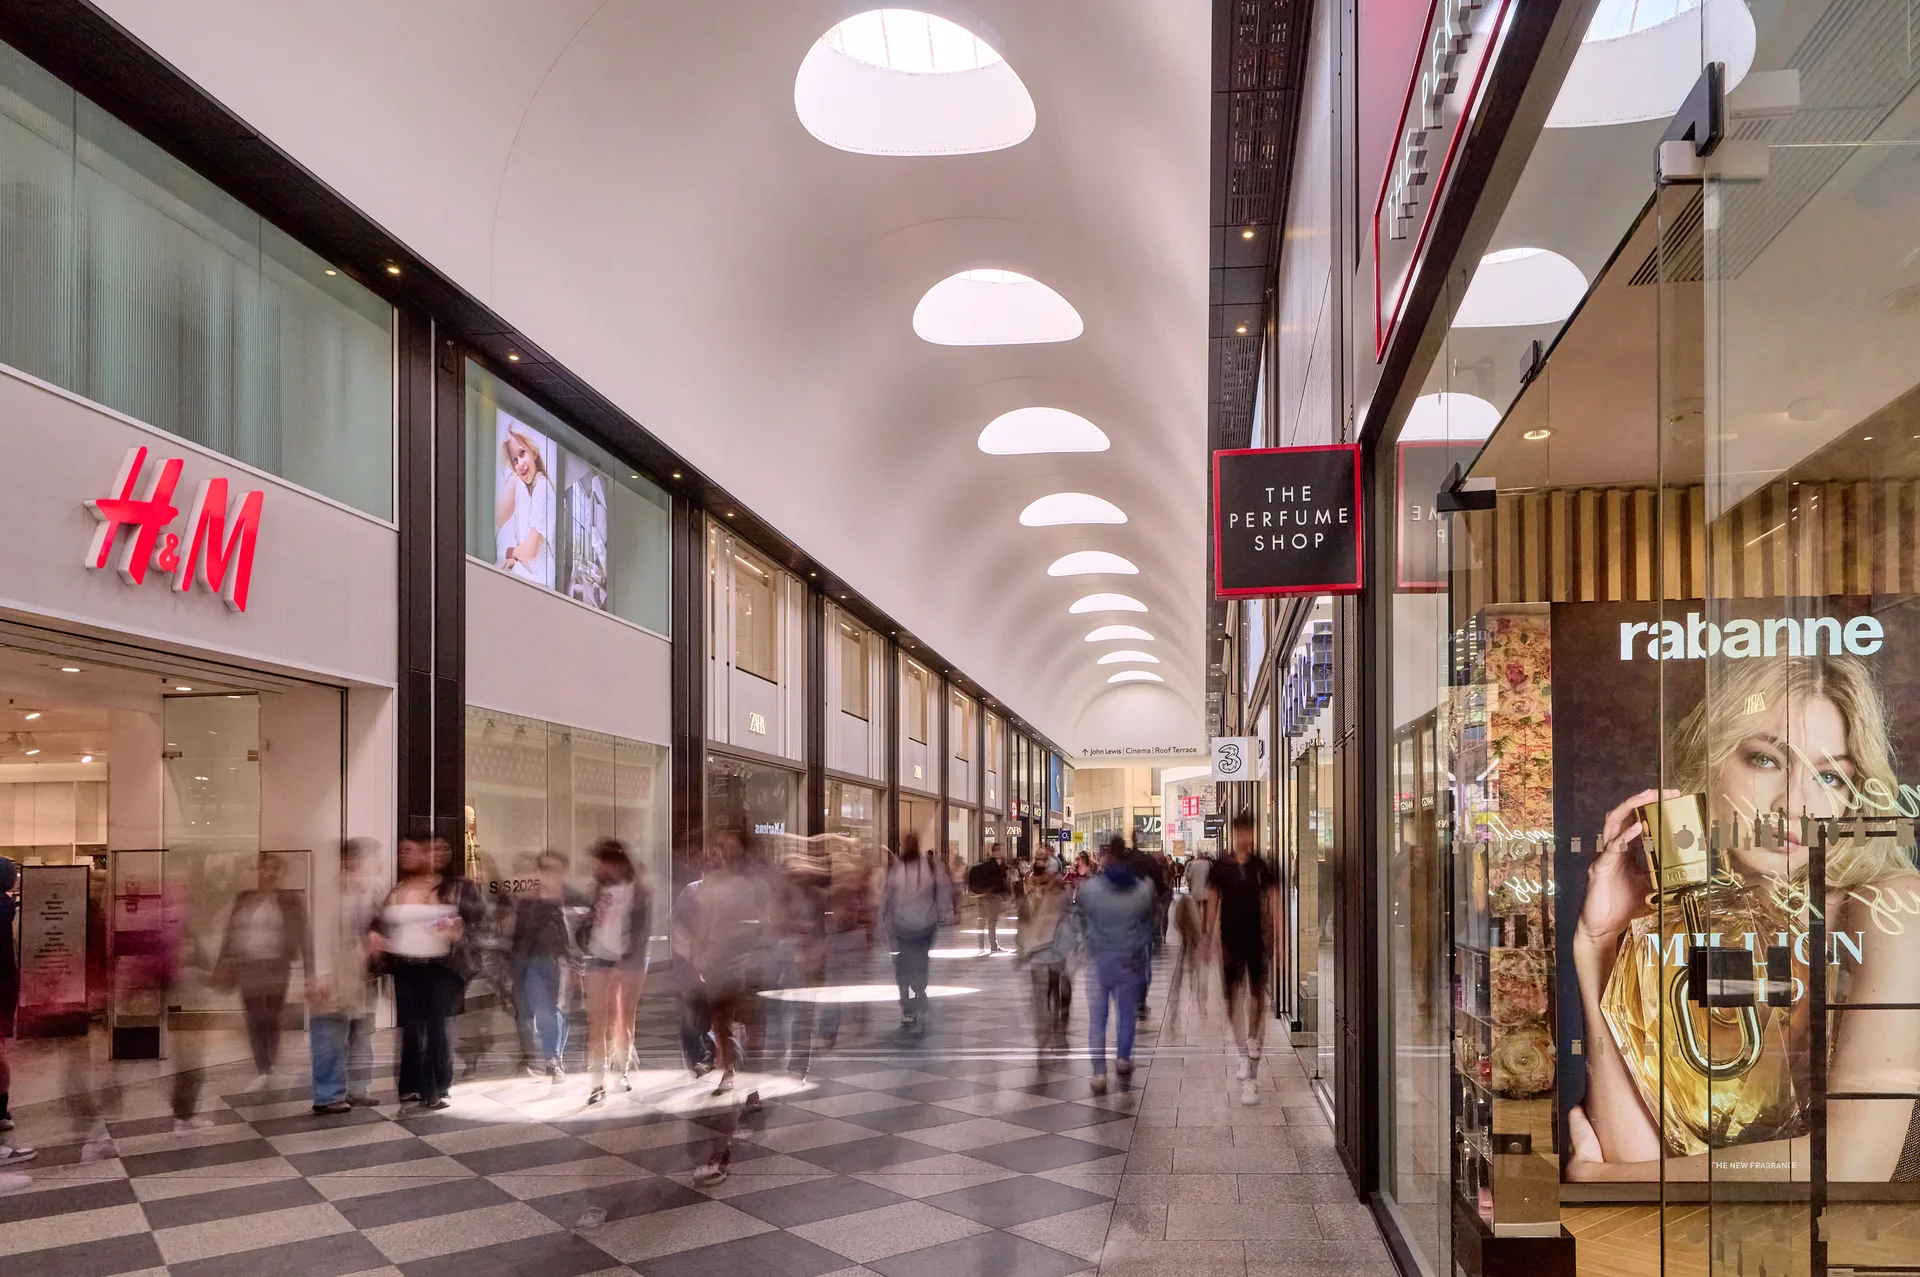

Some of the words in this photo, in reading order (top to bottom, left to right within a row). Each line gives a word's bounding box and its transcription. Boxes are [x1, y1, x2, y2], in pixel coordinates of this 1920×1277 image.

[1265, 485, 1311, 503] THE
[92, 445, 264, 613] H&M
[1229, 507, 1348, 529] PERFUME
[1254, 532, 1324, 551] SHOP
[1620, 612, 1884, 661] rabanne
[749, 712, 766, 735] ZARA
[1090, 748, 1104, 756] John
[1155, 746, 1171, 754] Roof
[1218, 743, 1242, 774] 3
[1729, 1161, 1748, 1169] NEW
